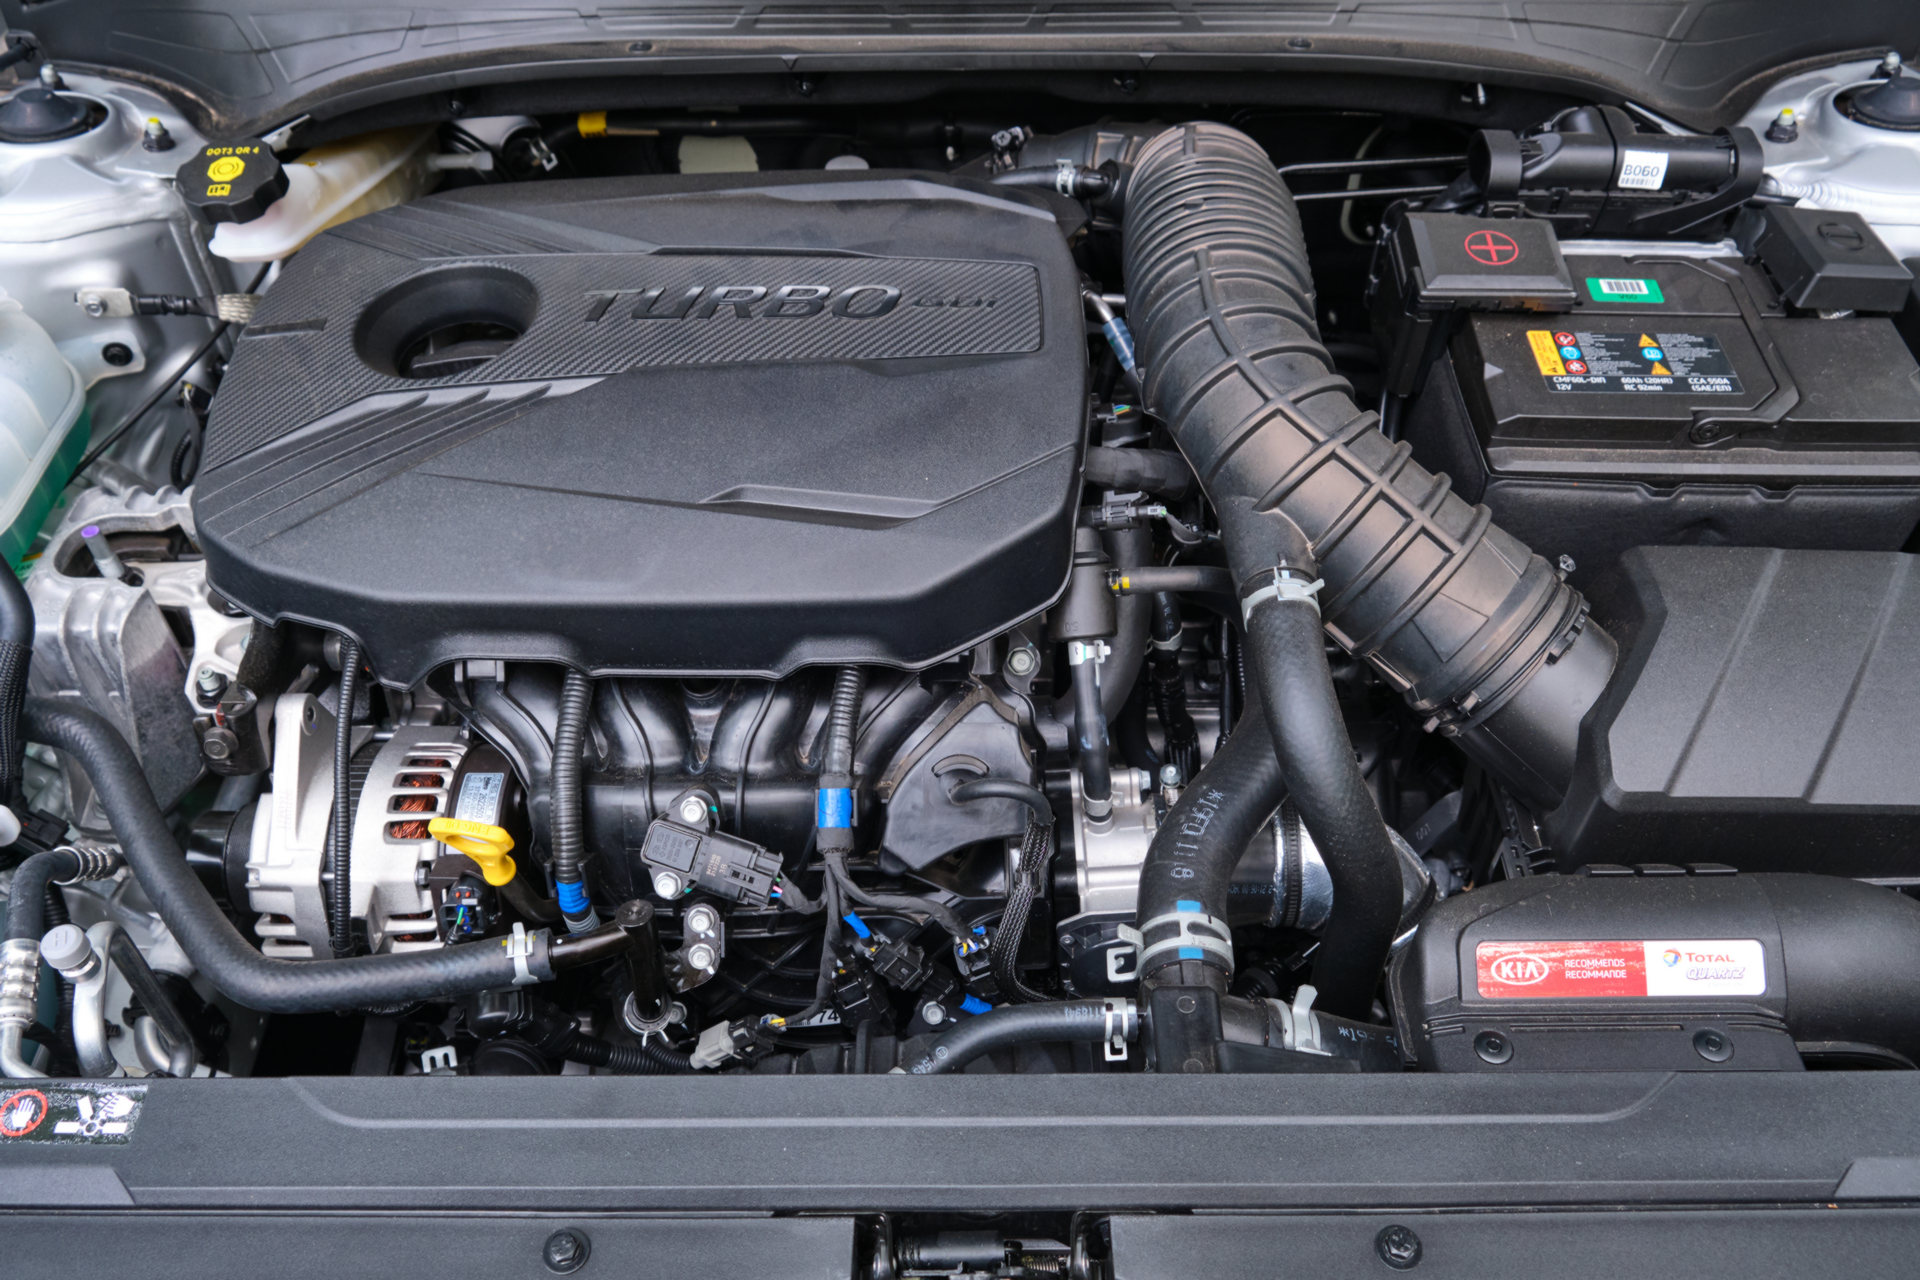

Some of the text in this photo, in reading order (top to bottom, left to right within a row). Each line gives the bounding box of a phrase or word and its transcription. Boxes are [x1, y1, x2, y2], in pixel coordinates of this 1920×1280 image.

[206, 146, 260, 156] DOT3 OR 4
[1623, 164, 1660, 177] B060
[583, 284, 901, 322] TURBO
[1644, 377, 1674, 385] (20HR)
[1564, 958, 1625, 968] RECOMMENDS
[1501, 962, 1539, 978] KIA
[1565, 969, 1627, 979] RECOMMANDE
[1686, 966, 1746, 980] QUARTZ
